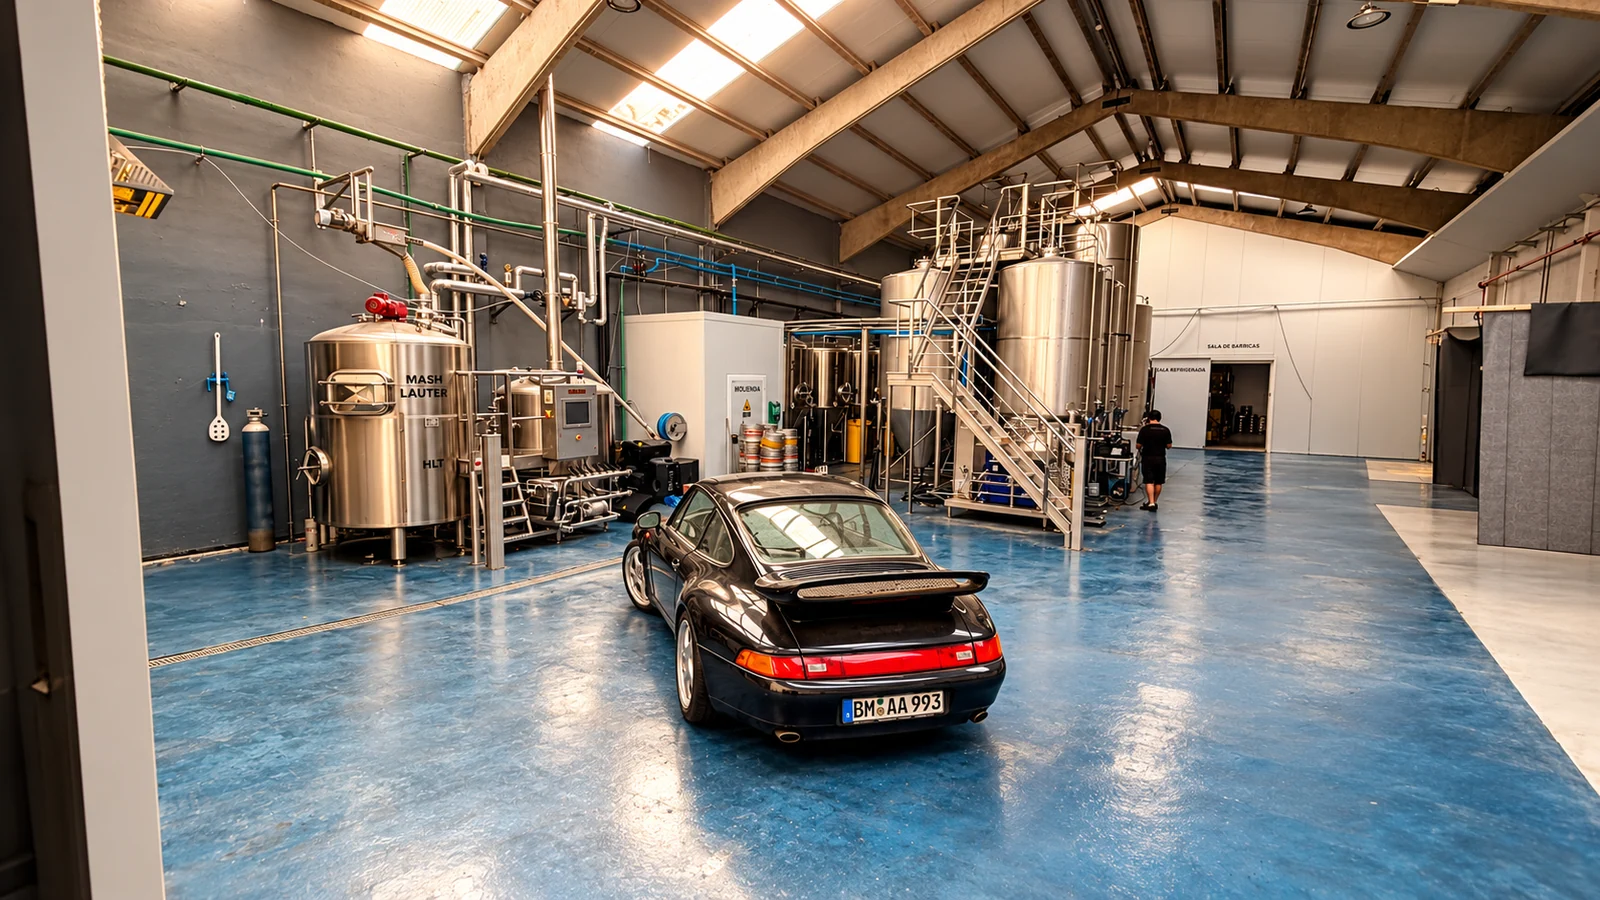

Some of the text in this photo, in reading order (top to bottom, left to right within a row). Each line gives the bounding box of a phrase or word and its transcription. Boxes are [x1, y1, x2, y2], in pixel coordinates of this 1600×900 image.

[406, 374, 443, 384] MASH
[400, 388, 448, 398] LAUTER
[423, 458, 445, 469] HLT
[854, 693, 941, 718] BM AA 993
